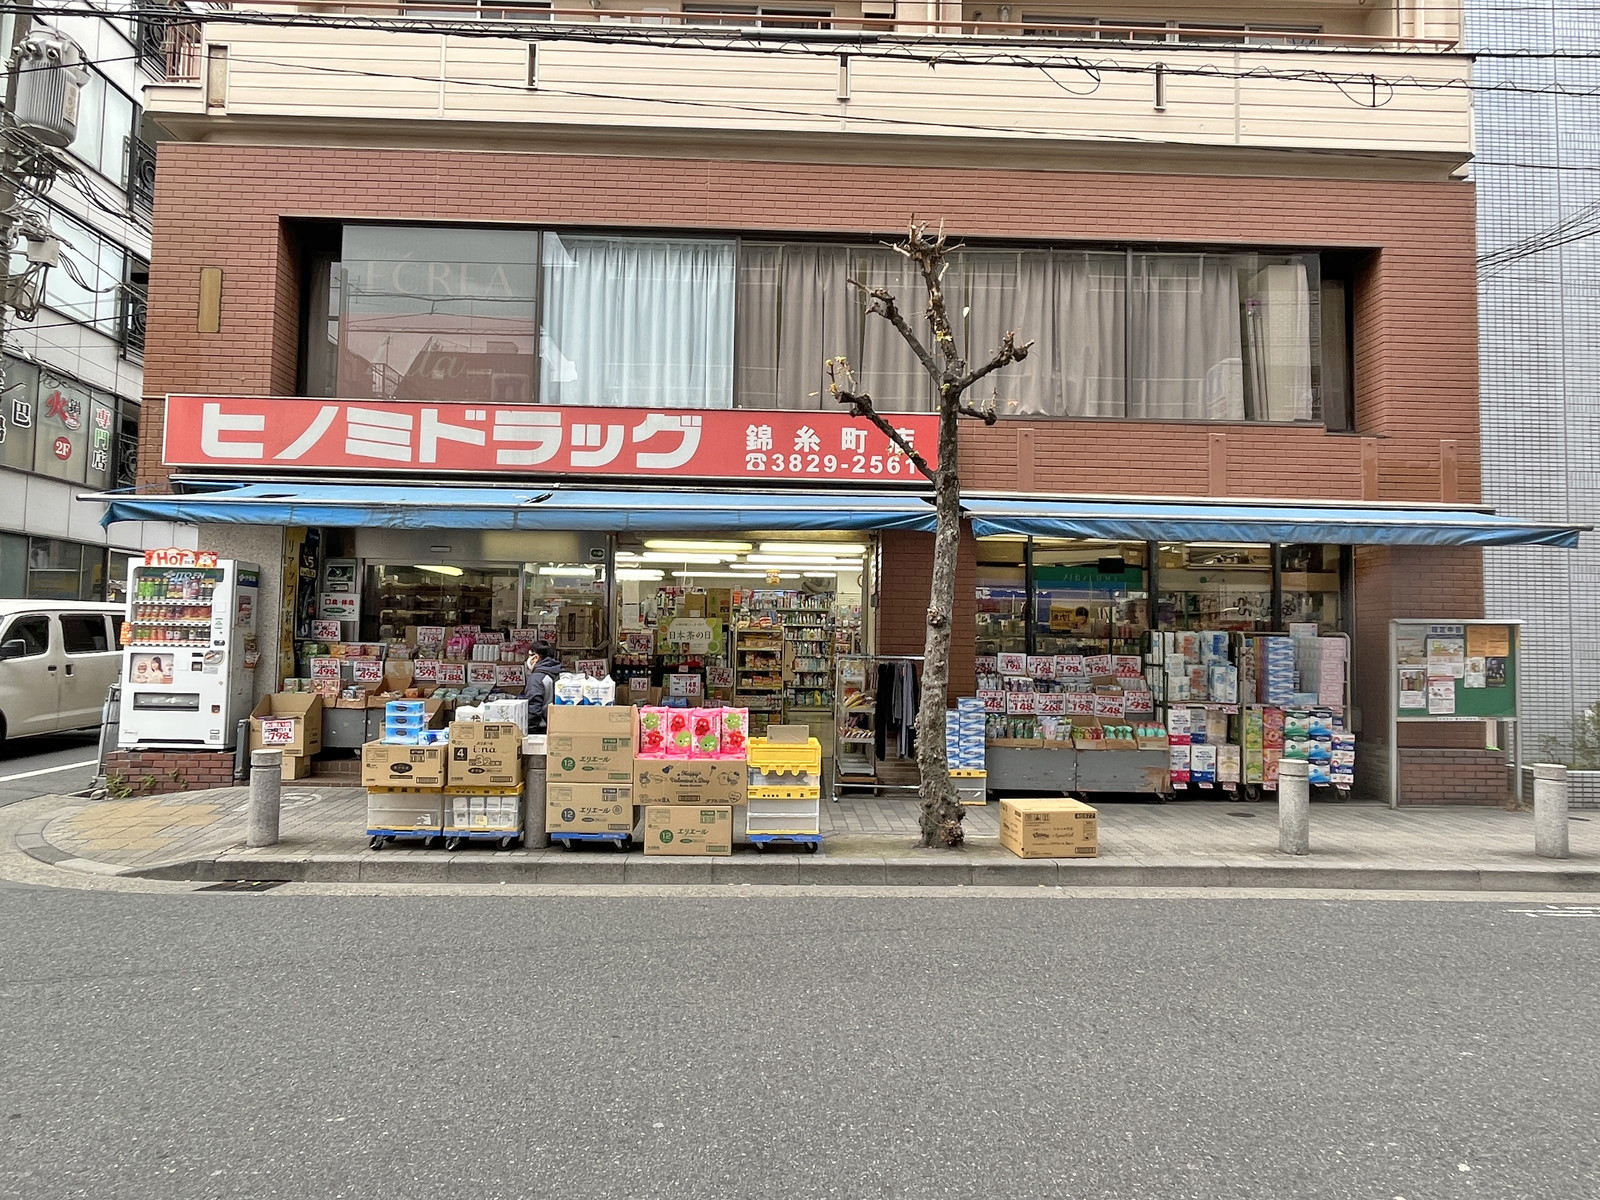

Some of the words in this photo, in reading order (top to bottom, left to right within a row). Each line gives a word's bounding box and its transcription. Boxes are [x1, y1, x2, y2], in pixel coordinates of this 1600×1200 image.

[201, 402, 702, 469] ヒノミドラッグ
[55, 441, 71, 456] 2F
[156, 552, 189, 566] HOT
[318, 630, 336, 638] 498
[669, 630, 711, 640] 日本茶の日
[317, 668, 336, 676] 498
[1060, 665, 1078, 673] 198
[359, 671, 379, 679] 498
[443, 673, 460, 681] 188
[270, 732, 290, 740] 798
[456, 748, 465, 758] 4
[563, 759, 573, 767] 12
[579, 756, 611, 764] エリエール
[563, 810, 574, 818] 12
[579, 807, 611, 815] エリエール
[662, 832, 672, 840] 12
[677, 828, 709, 836] エリエール
